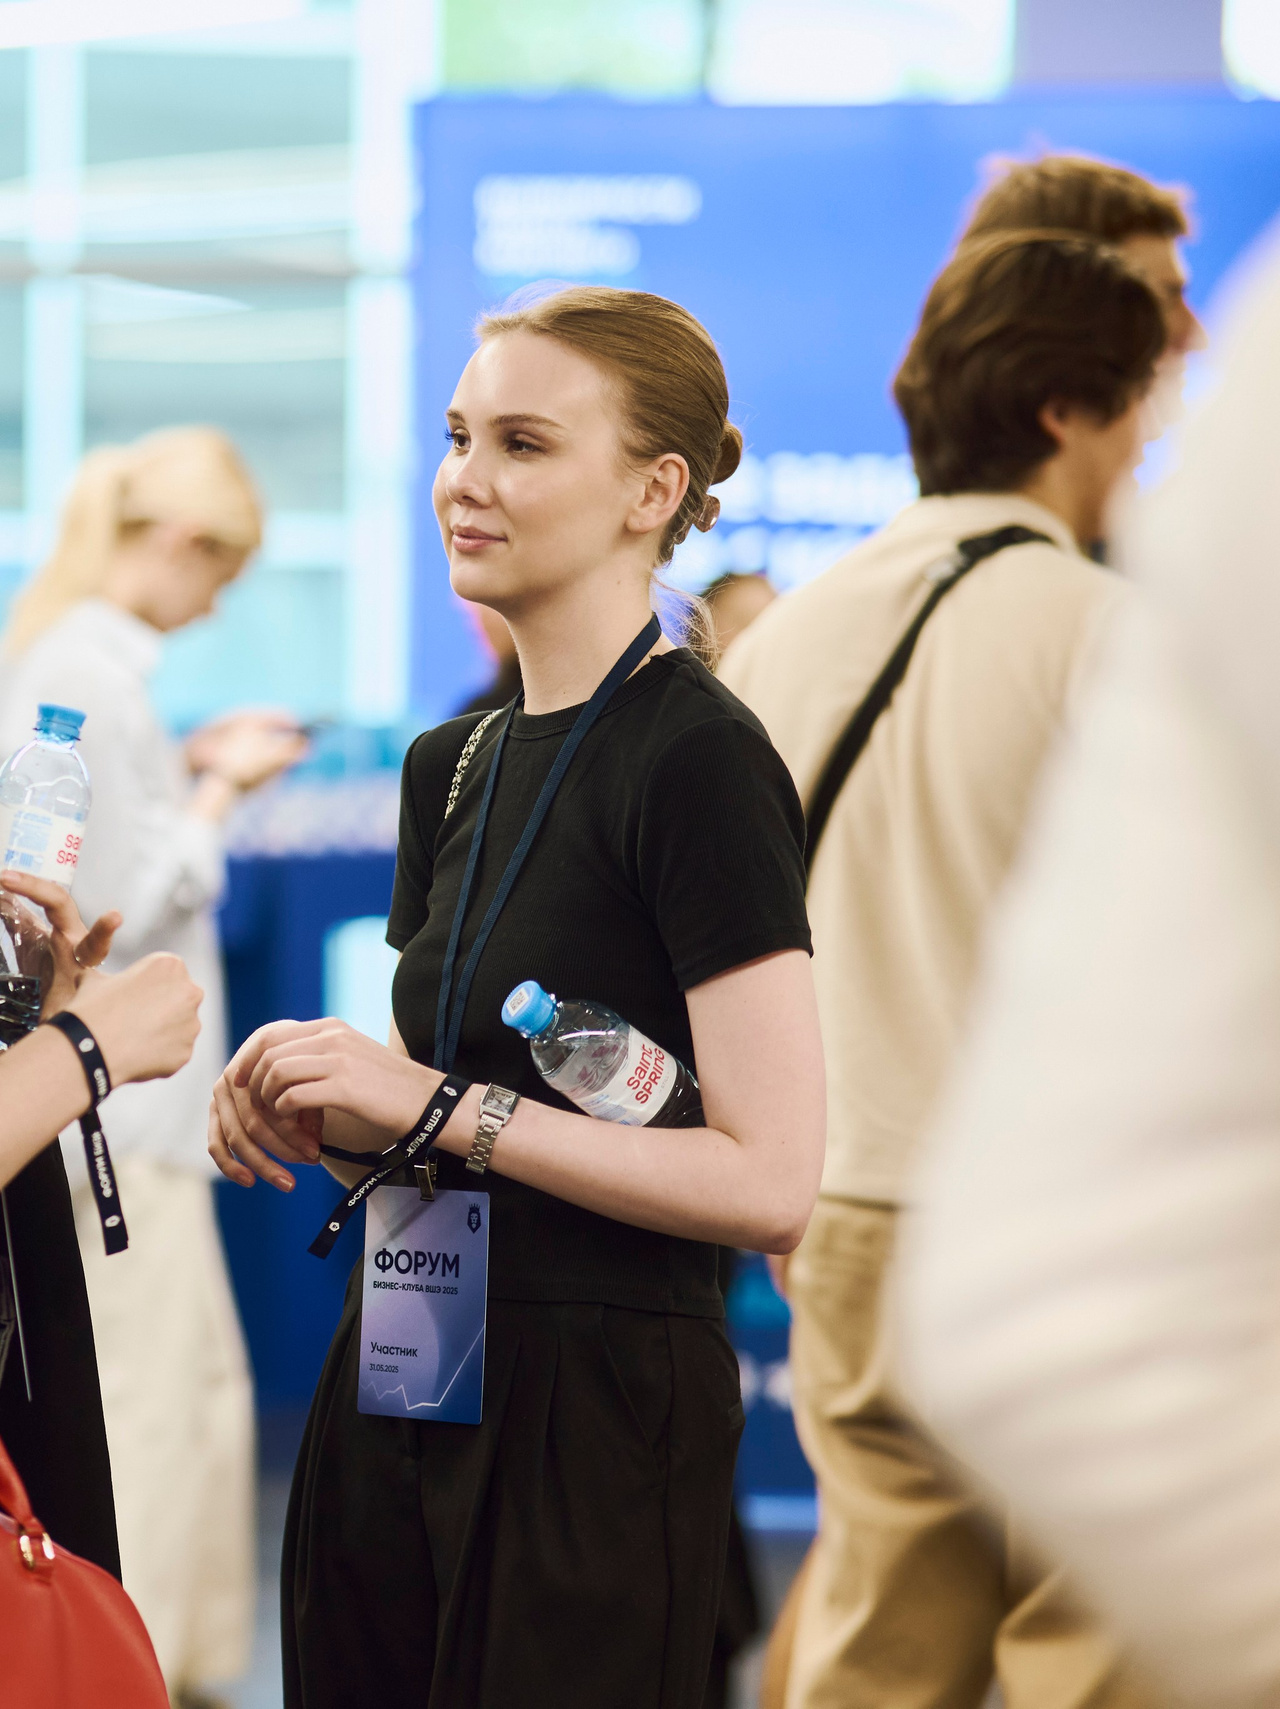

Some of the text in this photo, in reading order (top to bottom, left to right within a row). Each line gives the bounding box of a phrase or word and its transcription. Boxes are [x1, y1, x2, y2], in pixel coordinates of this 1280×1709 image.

[423, 1108, 443, 1133] ВШЭ
[347, 1177, 378, 1207] ФОРУМ
[374, 1247, 460, 1279] ФОРУМ
[372, 1280, 459, 1296] БИЗНЕС-КЛУБА ВШЭ 2025
[370, 1341, 418, 1358] Участник
[369, 1363, 399, 1374] 31.05.2025
